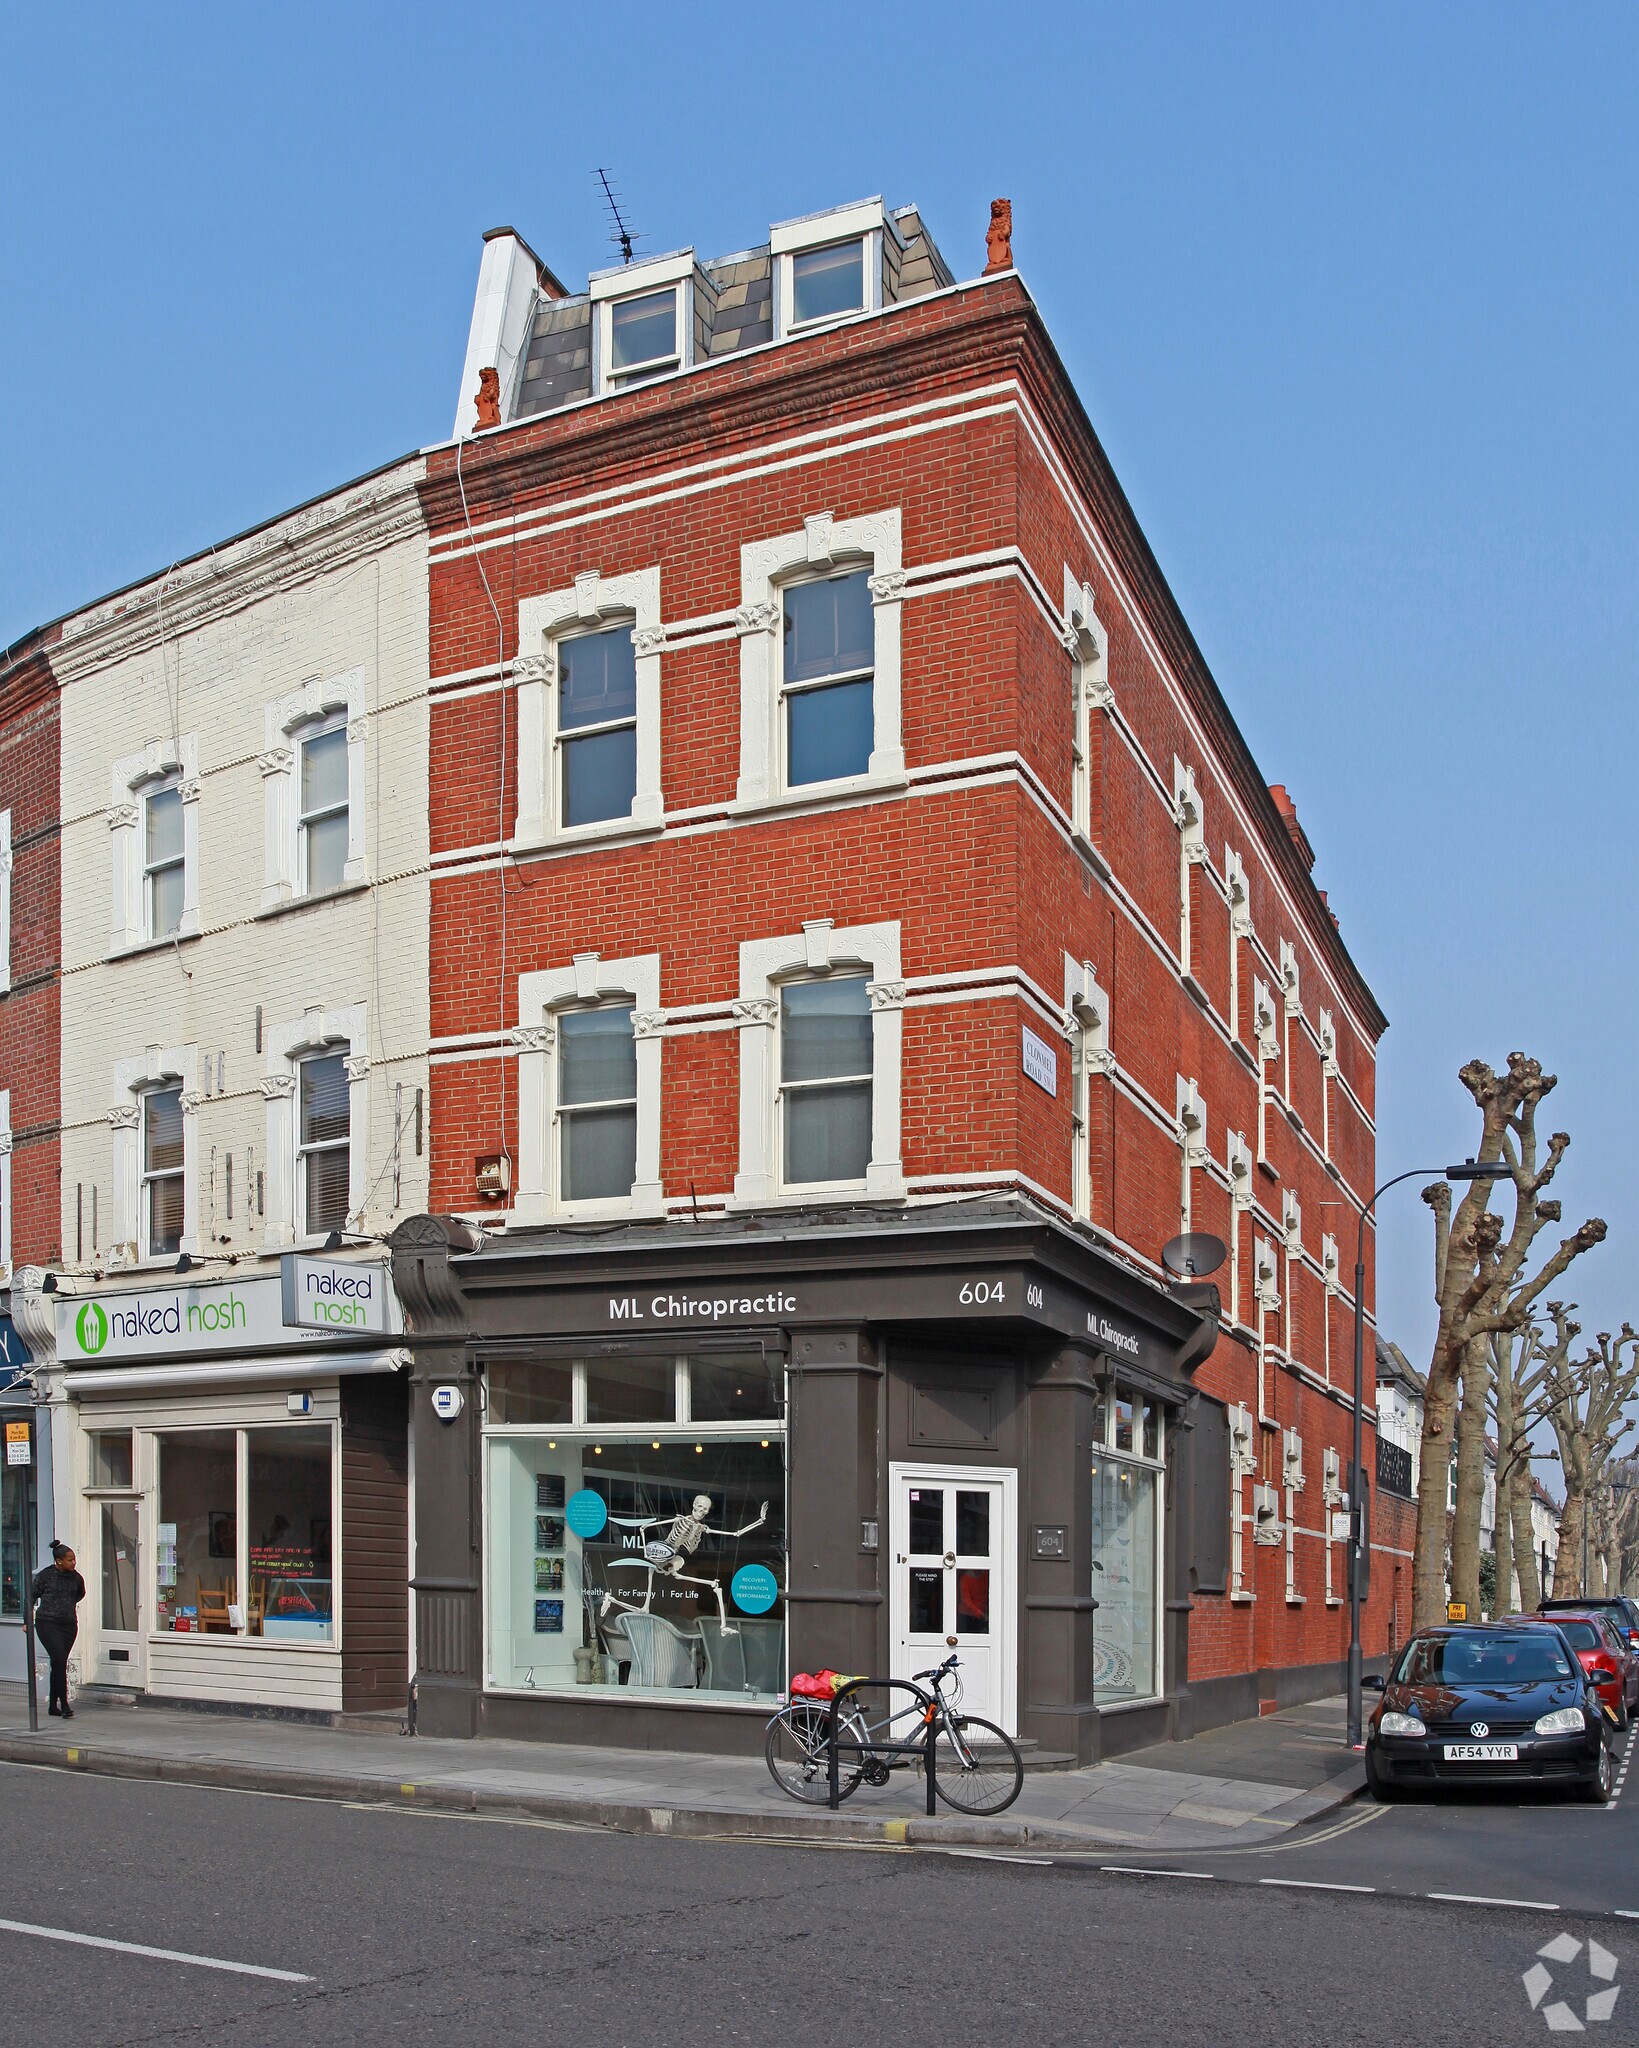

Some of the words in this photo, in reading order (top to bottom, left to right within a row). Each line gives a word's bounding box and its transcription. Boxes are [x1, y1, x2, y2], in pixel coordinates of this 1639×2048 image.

[1026, 1059, 1042, 1081] ROAD
[306, 1269, 372, 1300] naked
[958, 1281, 1006, 1304] 604
[1027, 1283, 1044, 1310] 604
[111, 1296, 180, 1339] naked
[187, 1291, 246, 1332] nosh
[314, 1299, 366, 1326] nosh
[609, 1298, 644, 1320] ML
[651, 1291, 797, 1321] Chiropractic
[1087, 1312, 1099, 1337] ML
[1099, 1319, 1140, 1355] Chiropractic
[622, 1535, 644, 1549] ML
[1041, 1537, 1059, 1546] 604
[581, 1588, 604, 1596] Health
[618, 1588, 630, 1597] For
[670, 1590, 684, 1598] For
[685, 1590, 699, 1599] Life
[1450, 1747, 1483, 1757] AF54
[1487, 1747, 1512, 1757] YYR
